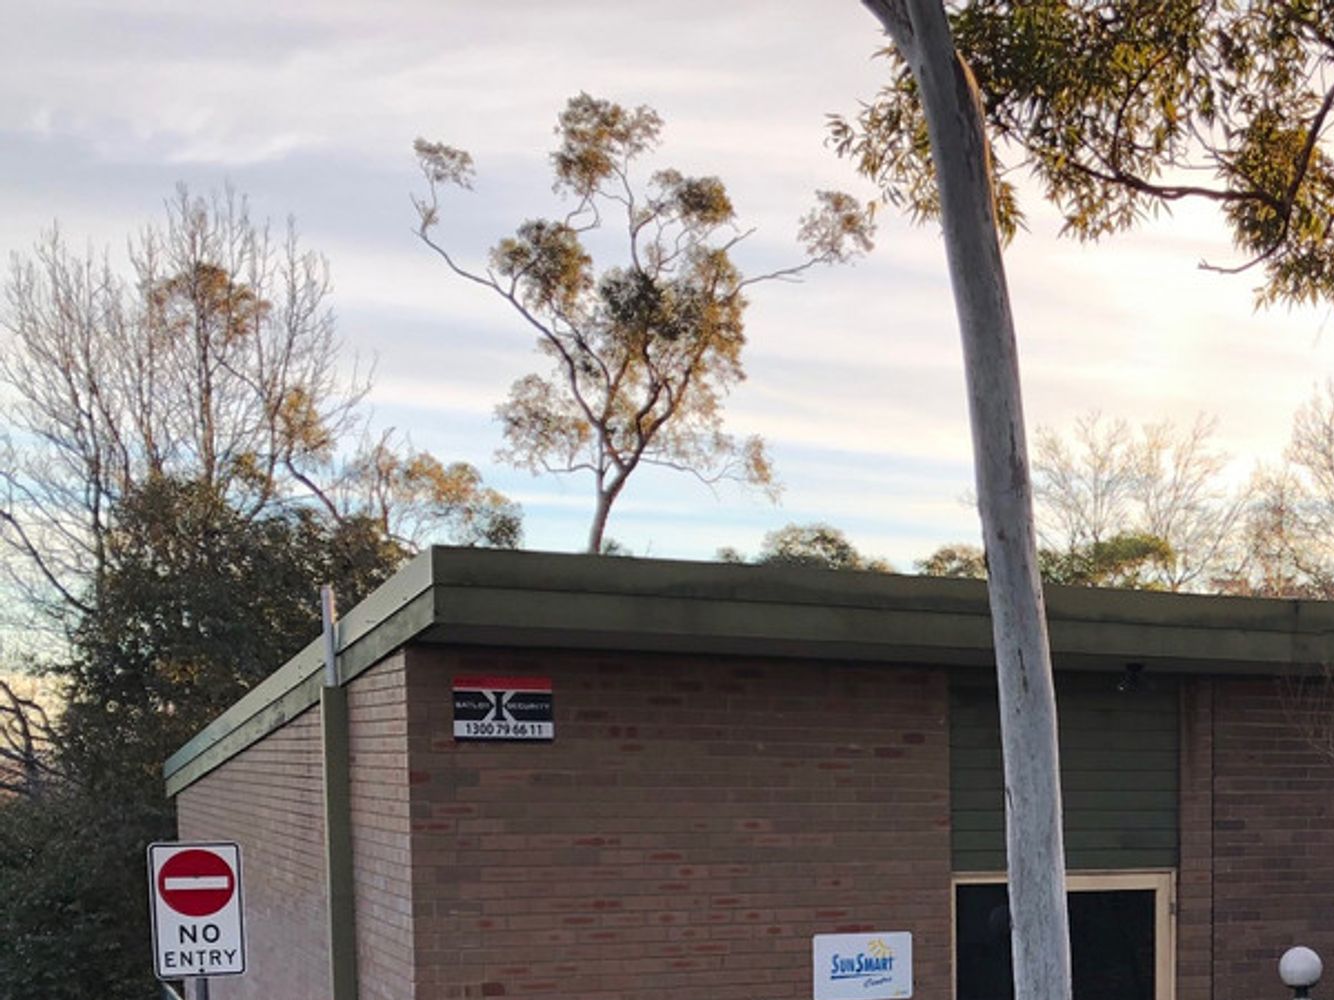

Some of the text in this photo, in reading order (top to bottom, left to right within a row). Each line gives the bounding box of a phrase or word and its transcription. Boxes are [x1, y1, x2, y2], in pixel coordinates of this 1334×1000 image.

[466, 722, 494, 735] 1300
[530, 724, 543, 735] 11
[179, 923, 221, 944] NO
[164, 949, 237, 968] ENTRY
